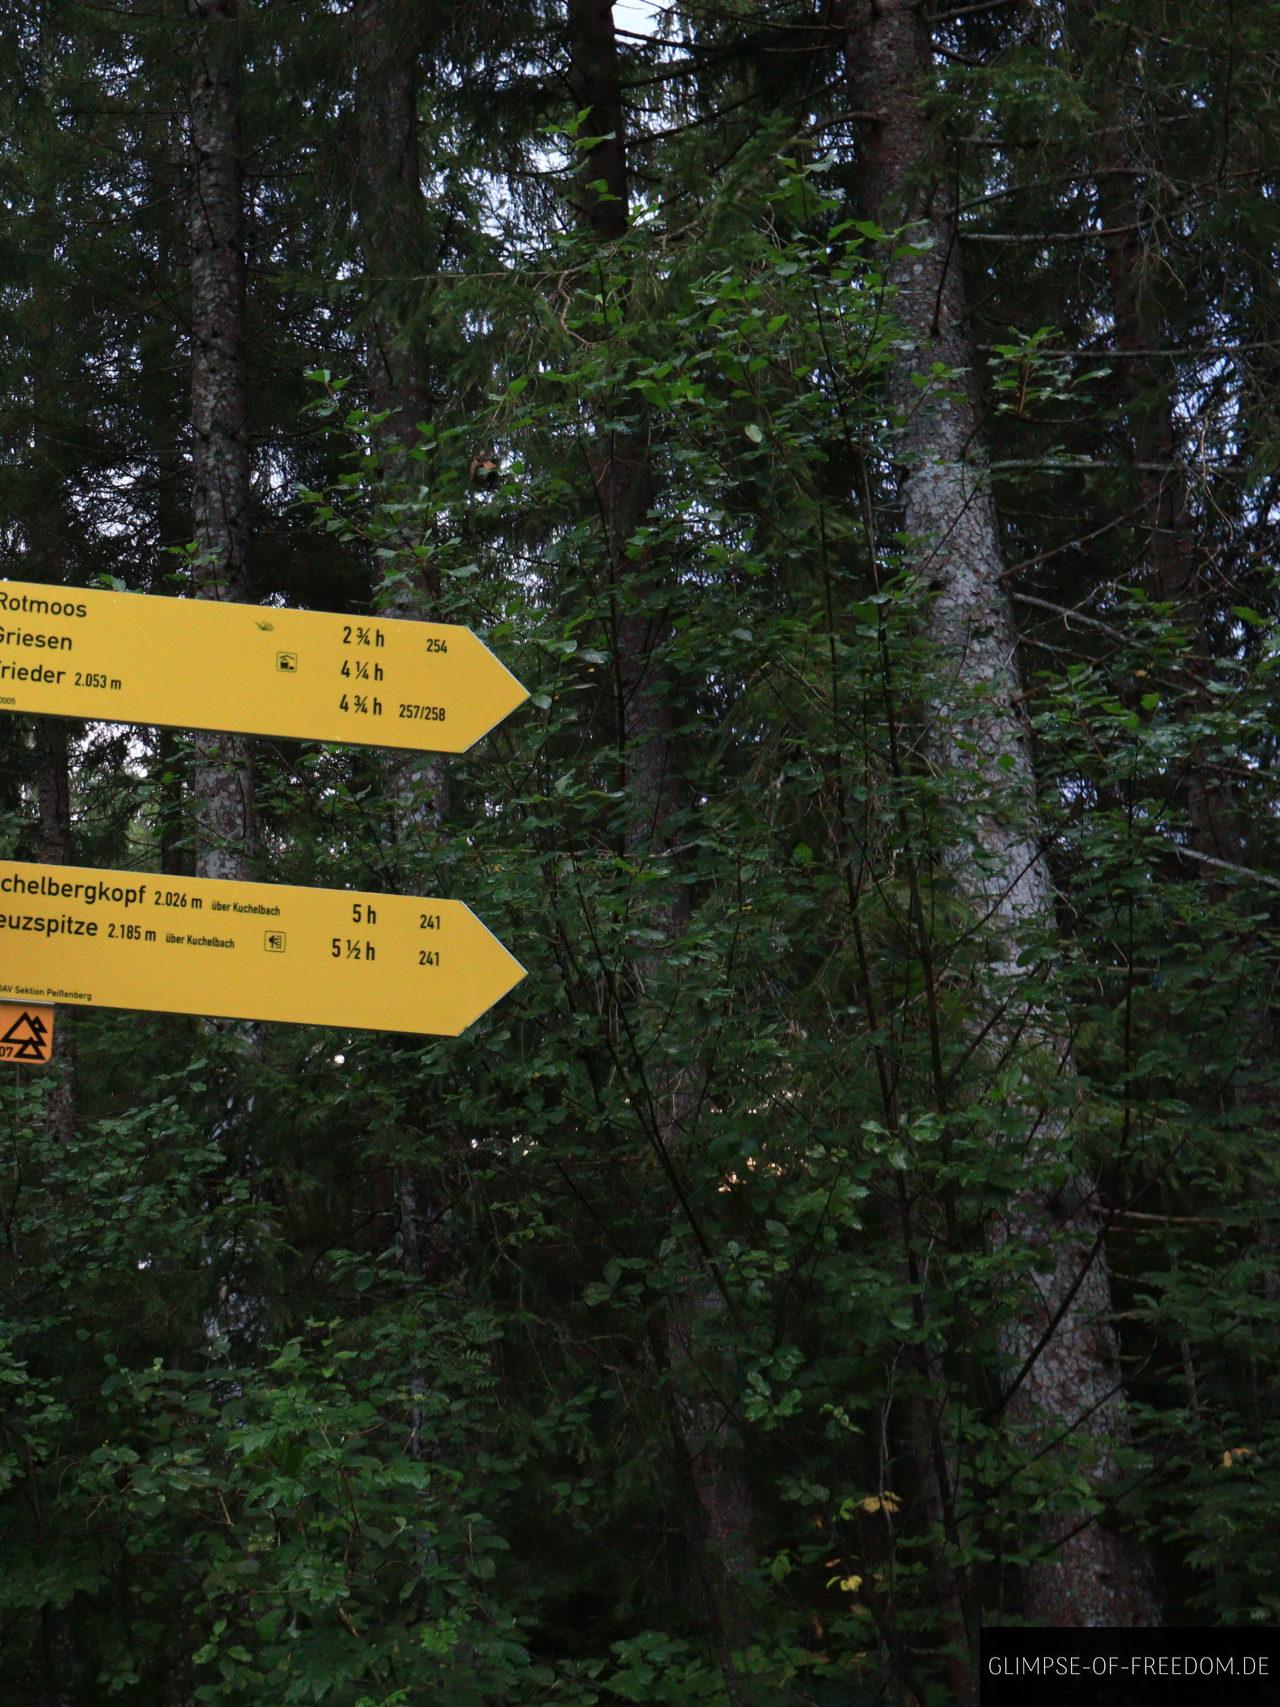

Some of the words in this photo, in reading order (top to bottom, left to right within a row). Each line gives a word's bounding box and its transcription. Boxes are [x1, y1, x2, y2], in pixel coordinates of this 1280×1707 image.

[342, 626, 352, 644] 2
[376, 629, 384, 647] h
[426, 638, 448, 654] 254
[74, 672, 108, 688] 2.053
[110, 677, 122, 690] m
[341, 660, 350, 678] 4
[374, 662, 384, 681] h
[339, 694, 350, 712] 4
[372, 697, 382, 716] h
[399, 704, 446, 722] 257/258
[154, 890, 188, 908] 2.026
[191, 896, 202, 909] m
[212, 900, 231, 914] über
[232, 902, 280, 917] Kuchelbach
[352, 904, 362, 924] 5
[367, 904, 376, 925] h
[420, 914, 441, 931] 241
[108, 922, 142, 941] 2.185
[144, 928, 156, 942] m
[165, 932, 185, 946] über
[186, 934, 235, 950] Kuchelbach
[331, 938, 342, 958] 5
[366, 940, 376, 961] h
[418, 951, 440, 967] 241
[15, 986, 44, 995] Sektion
